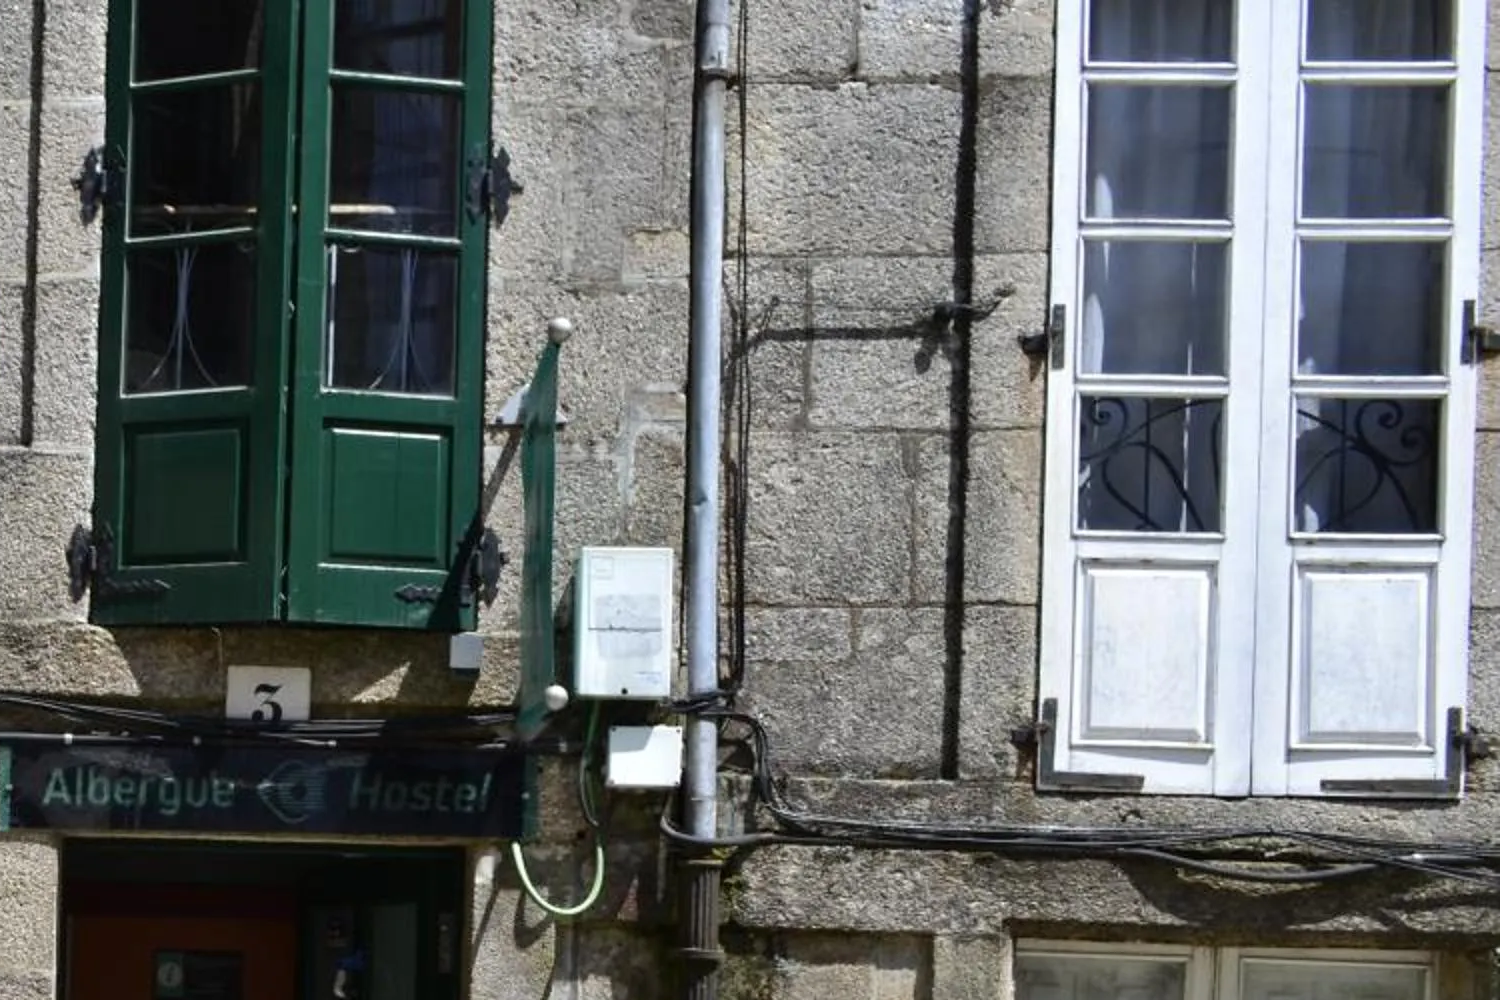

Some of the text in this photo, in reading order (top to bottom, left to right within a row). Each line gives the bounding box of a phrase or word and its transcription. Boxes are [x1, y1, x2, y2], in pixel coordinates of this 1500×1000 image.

[251, 683, 283, 721] 3
[42, 766, 493, 816] Albergue Hostel
